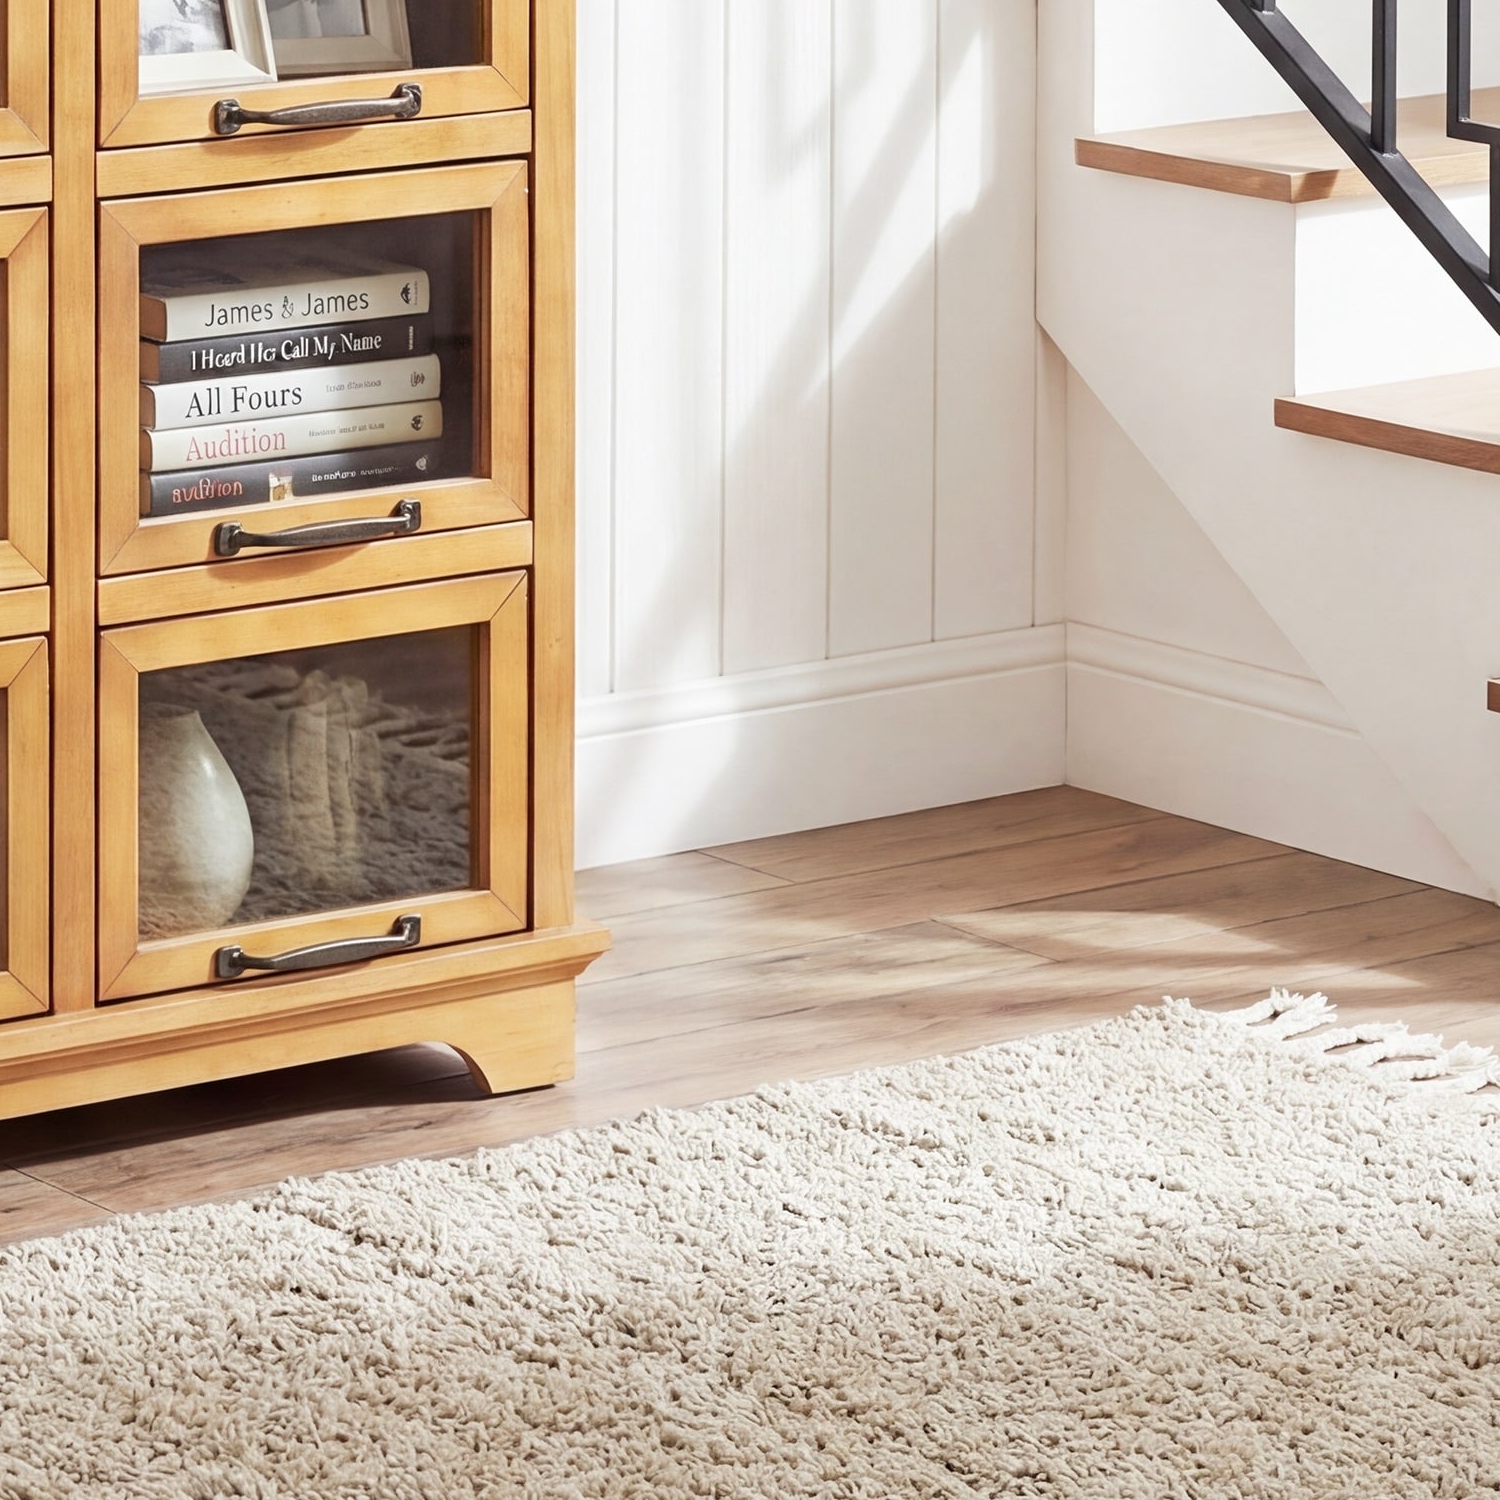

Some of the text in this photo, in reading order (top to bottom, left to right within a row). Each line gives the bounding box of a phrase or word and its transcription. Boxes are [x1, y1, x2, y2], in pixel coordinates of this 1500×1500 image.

[205, 292, 370, 328] James & James
[280, 336, 309, 361] Call
[340, 332, 382, 353] Name
[185, 388, 222, 419] All
[230, 385, 303, 414] Fours
[185, 427, 287, 463] Audition
